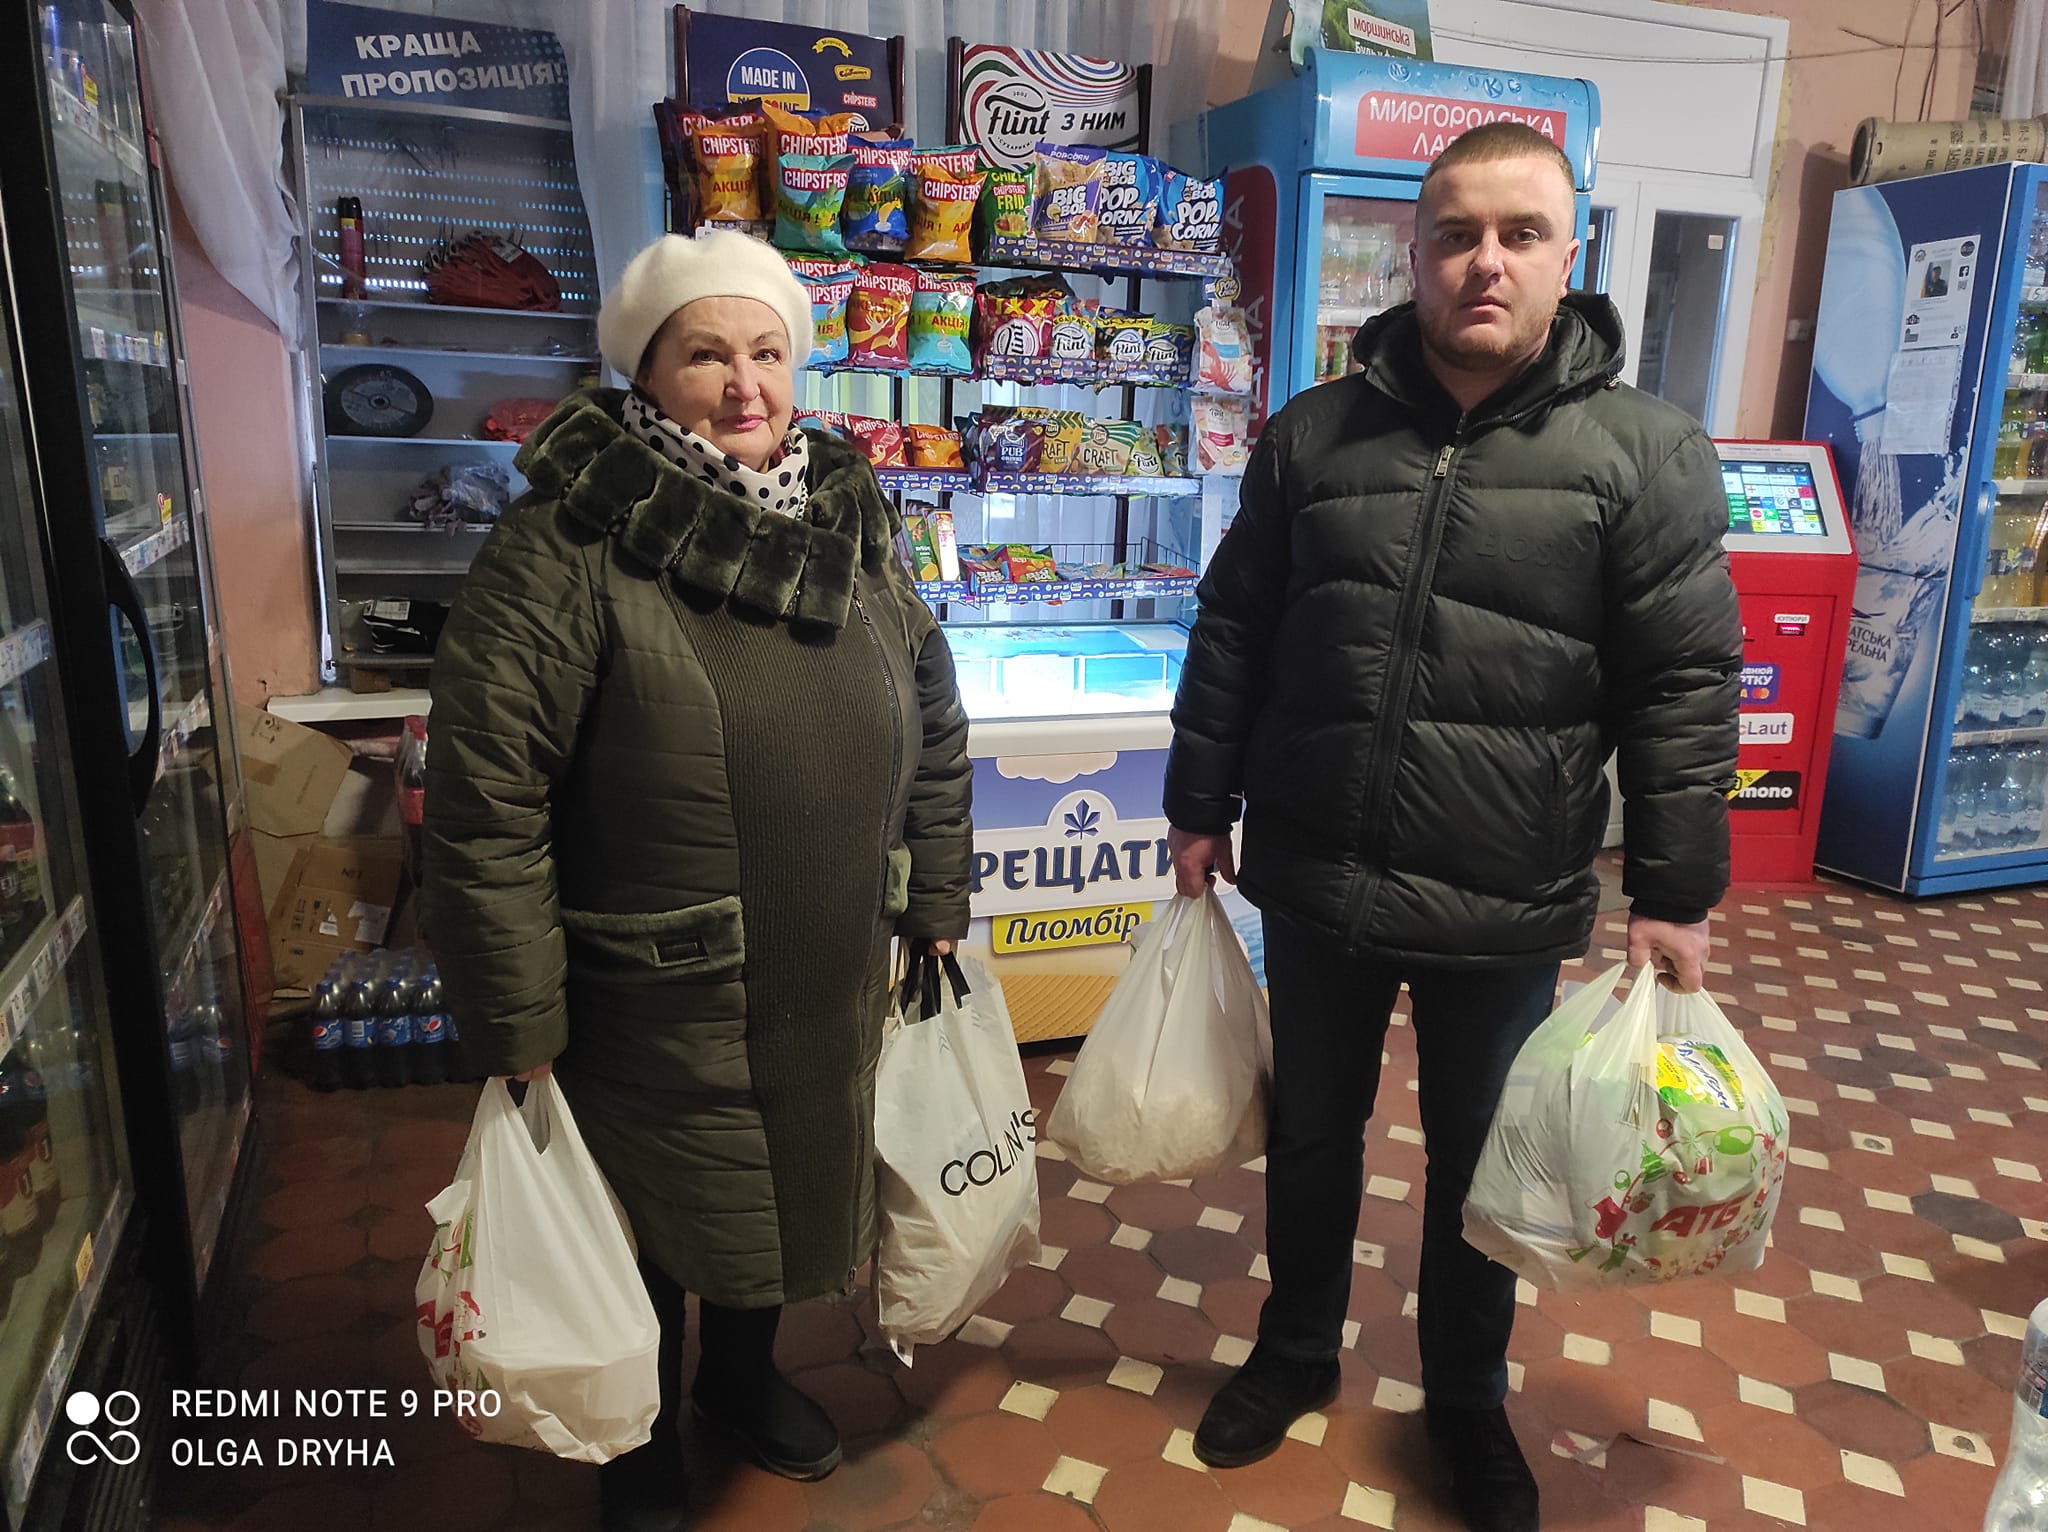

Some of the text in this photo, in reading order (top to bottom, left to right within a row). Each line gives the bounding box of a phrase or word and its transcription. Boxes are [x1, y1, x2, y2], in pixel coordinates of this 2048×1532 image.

[355, 31, 481, 59] КРАЩА
[340, 62, 565, 98] ПРОПОЗИЦІЯ!
[741, 66, 796, 90] MADE IN
[843, 93, 877, 107] CHIPSTERS
[1080, 112, 1126, 130] НИМ
[702, 138, 761, 154] CHIPSTERS
[781, 134, 848, 156] CHIPSTERS
[852, 147, 911, 168] CHIPSTERS
[1051, 150, 1089, 161] POPCORN
[1105, 161, 1136, 176] BIG
[785, 171, 847, 190] CHIPSTERS
[1110, 175, 1136, 185] BOB
[924, 181, 981, 200] CHIPSTERS
[1053, 186, 1086, 205] BIG
[1192, 188, 1216, 200] BOB
[1061, 203, 1086, 217] BOB
[1101, 210, 1143, 225] ORN
[1177, 201, 1218, 225] POP
[1172, 223, 1218, 240] CORN
[855, 275, 911, 295] CHIPSTERS
[1219, 280, 1235, 289] POP
[1001, 448, 1023, 457] PUB
[1084, 447, 1118, 468] CRAFT
[1739, 786, 1792, 798] mono
[1005, 906, 1140, 945] Пломбір
[940, 1110, 1036, 1196] COLIN'S
